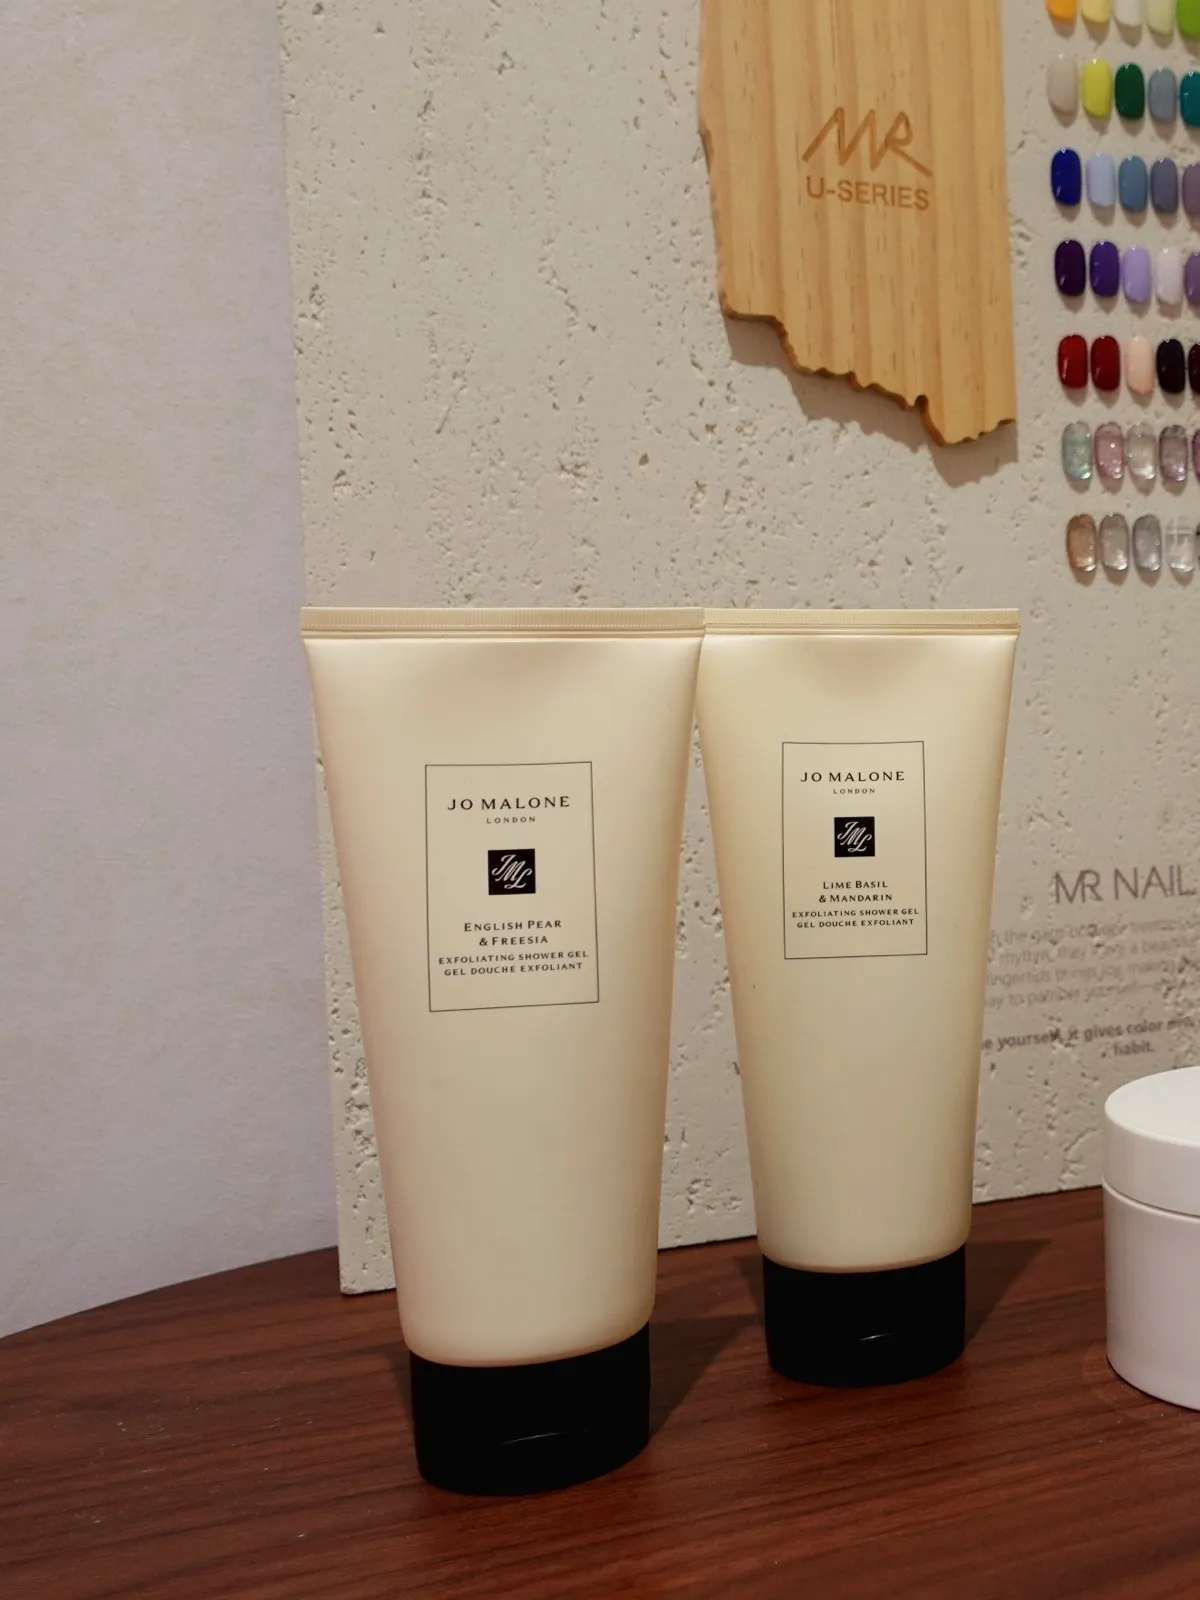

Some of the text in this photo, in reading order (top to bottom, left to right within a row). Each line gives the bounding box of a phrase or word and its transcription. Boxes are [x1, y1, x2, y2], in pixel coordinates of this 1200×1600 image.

[806, 176, 929, 211] U-SERIES
[801, 771, 905, 782] JO MALONE
[448, 796, 570, 810] JO MALONE
[1053, 865, 1196, 904] MR NAIL
[819, 895, 826, 903] &
[479, 938, 488, 946] &
[439, 950, 588, 965] EXFOLIATING SHOWER GEL
[444, 963, 583, 976] GEL DOUCHE EXFOLIANT
[1084, 1025, 1123, 1042] gives
[1126, 1019, 1162, 1035] color
